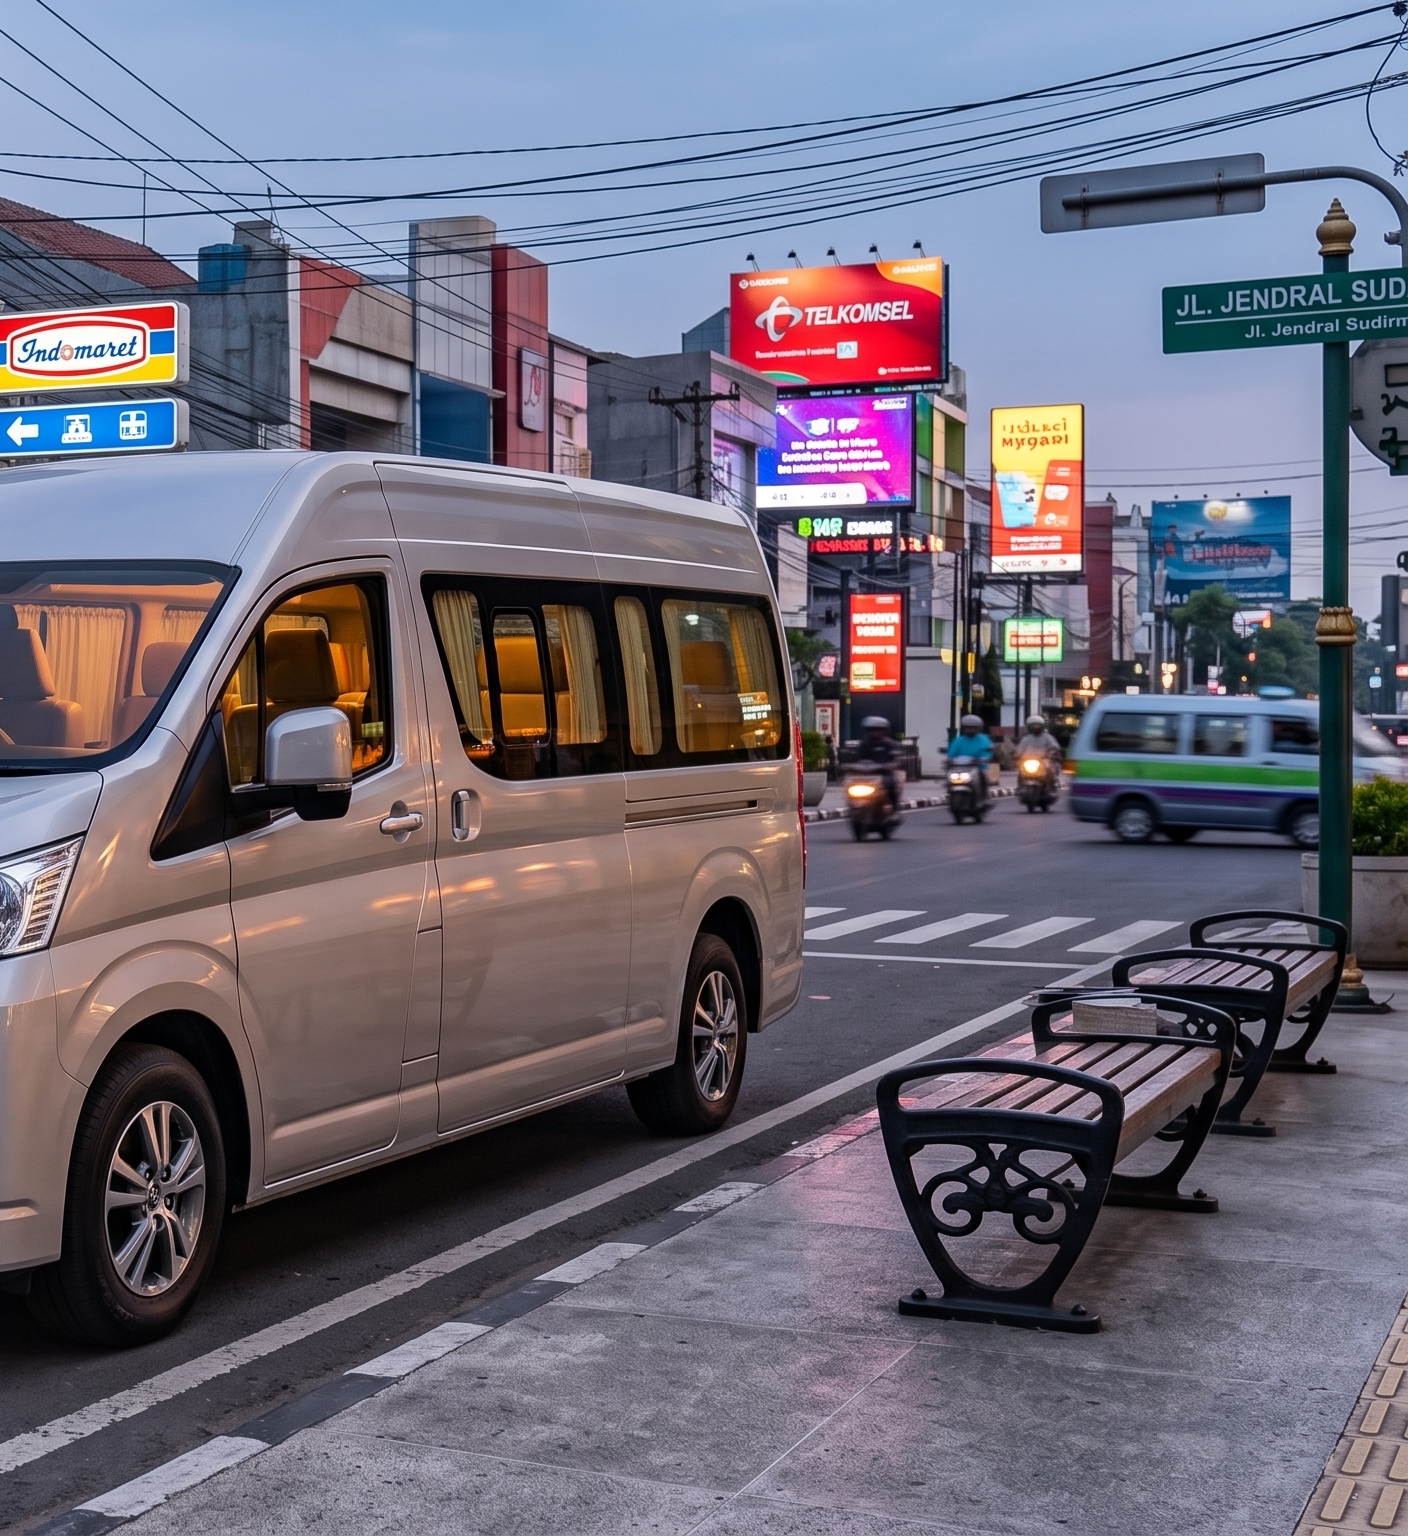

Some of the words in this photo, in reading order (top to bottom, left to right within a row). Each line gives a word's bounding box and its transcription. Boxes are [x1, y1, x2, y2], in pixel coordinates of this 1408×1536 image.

[1176, 294, 1213, 317] JL.
[1220, 282, 1342, 313] JENDRAL
[1351, 277, 1408, 302] SUD
[804, 300, 914, 326] TELKOMSEL
[1244, 325, 1266, 338] Jl.
[1271, 318, 1340, 337] Jendral
[17, 335, 138, 363] Indomaret
